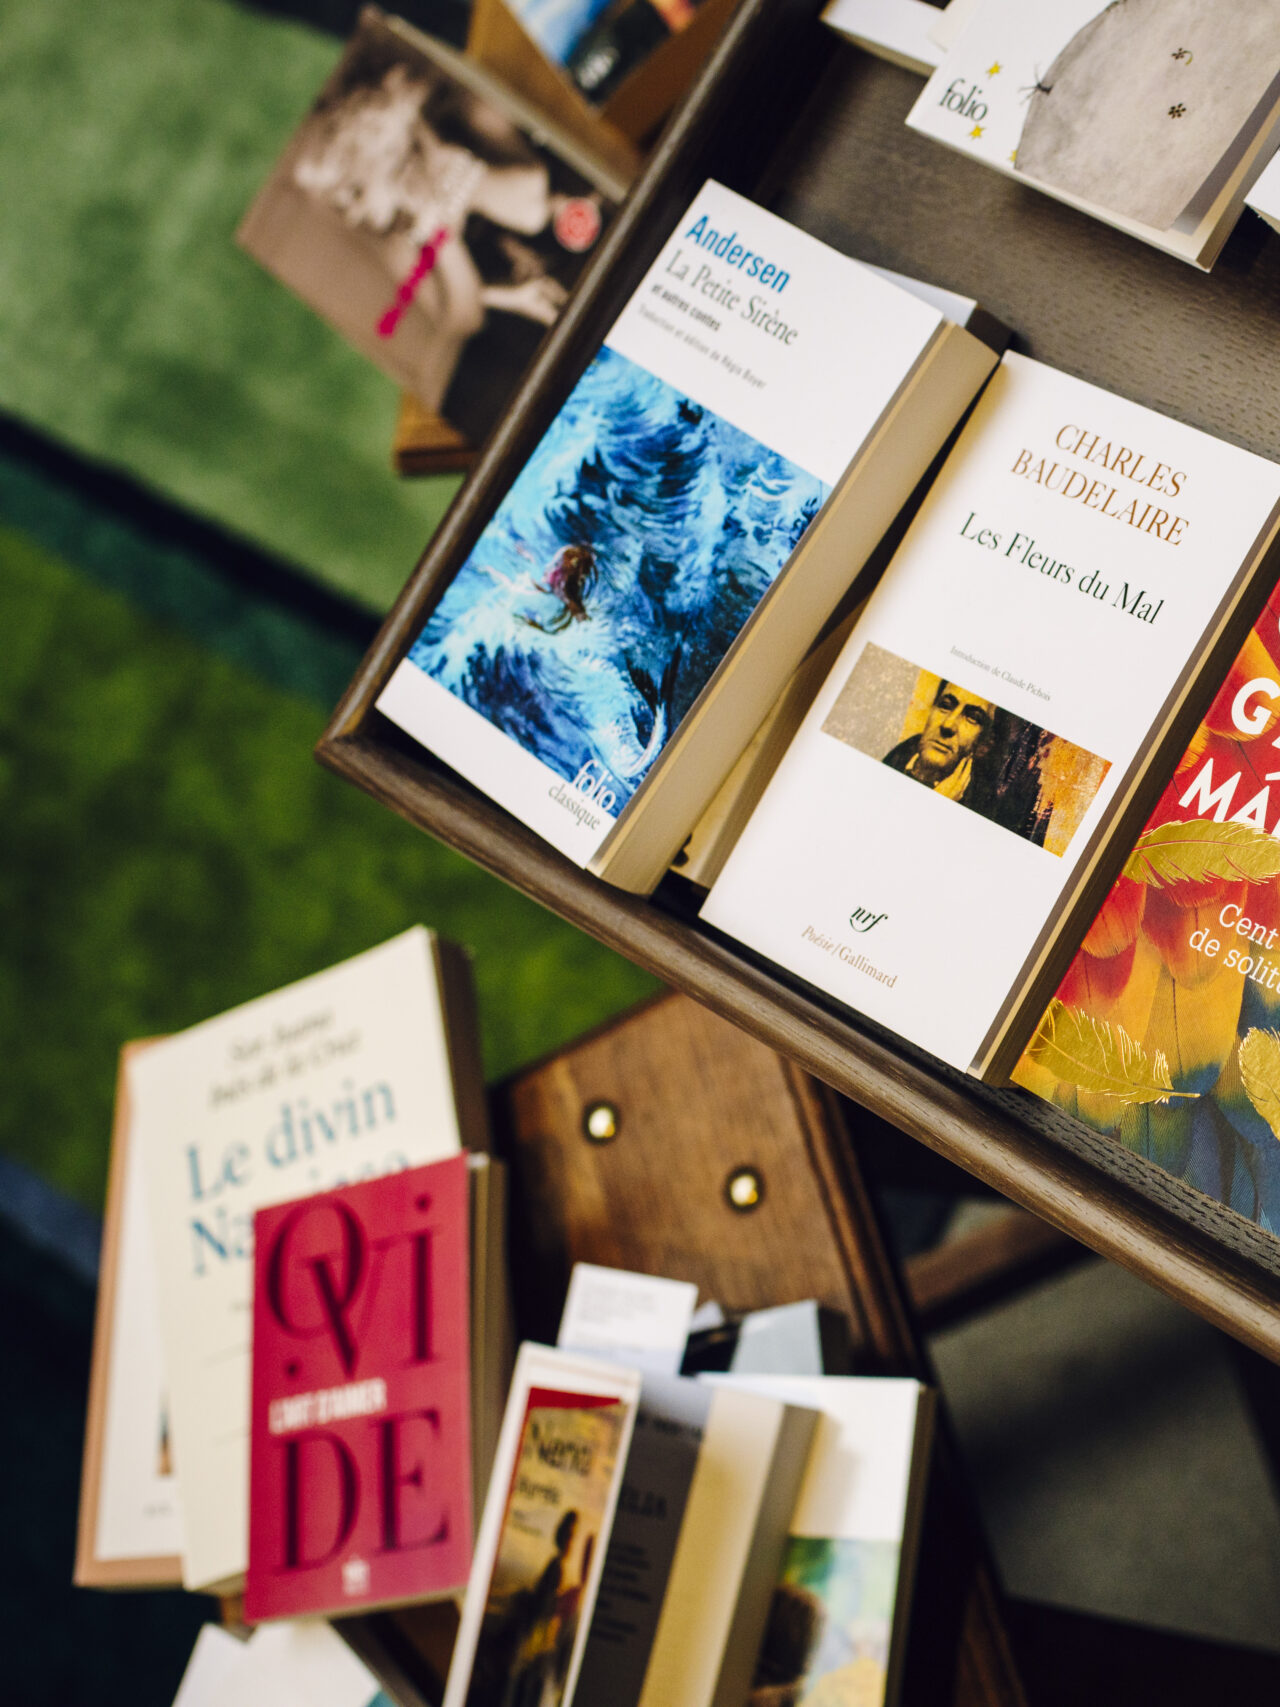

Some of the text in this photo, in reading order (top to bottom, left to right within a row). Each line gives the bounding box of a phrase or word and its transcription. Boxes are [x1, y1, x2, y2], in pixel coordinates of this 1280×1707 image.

[939, 77, 988, 122] folio
[685, 214, 791, 293] Andersen
[651, 284, 721, 332] et autres contes
[665, 249, 799, 347] La Petite Sirène
[1055, 423, 1188, 498] CHARLES
[1011, 449, 1190, 546] BAUDELAIRE
[959, 512, 1165, 625] Les Fleurs du Mal
[950, 645, 991, 672] Introduction
[991, 666, 1001, 677] de
[1001, 671, 1026, 688] Claude
[548, 782, 600, 830] classique
[571, 759, 617, 813] folio
[850, 906, 888, 933] nrf
[1188, 928, 1221, 957] de
[1218, 903, 1280, 949] Cent
[186, 1076, 397, 1202] Le divin
